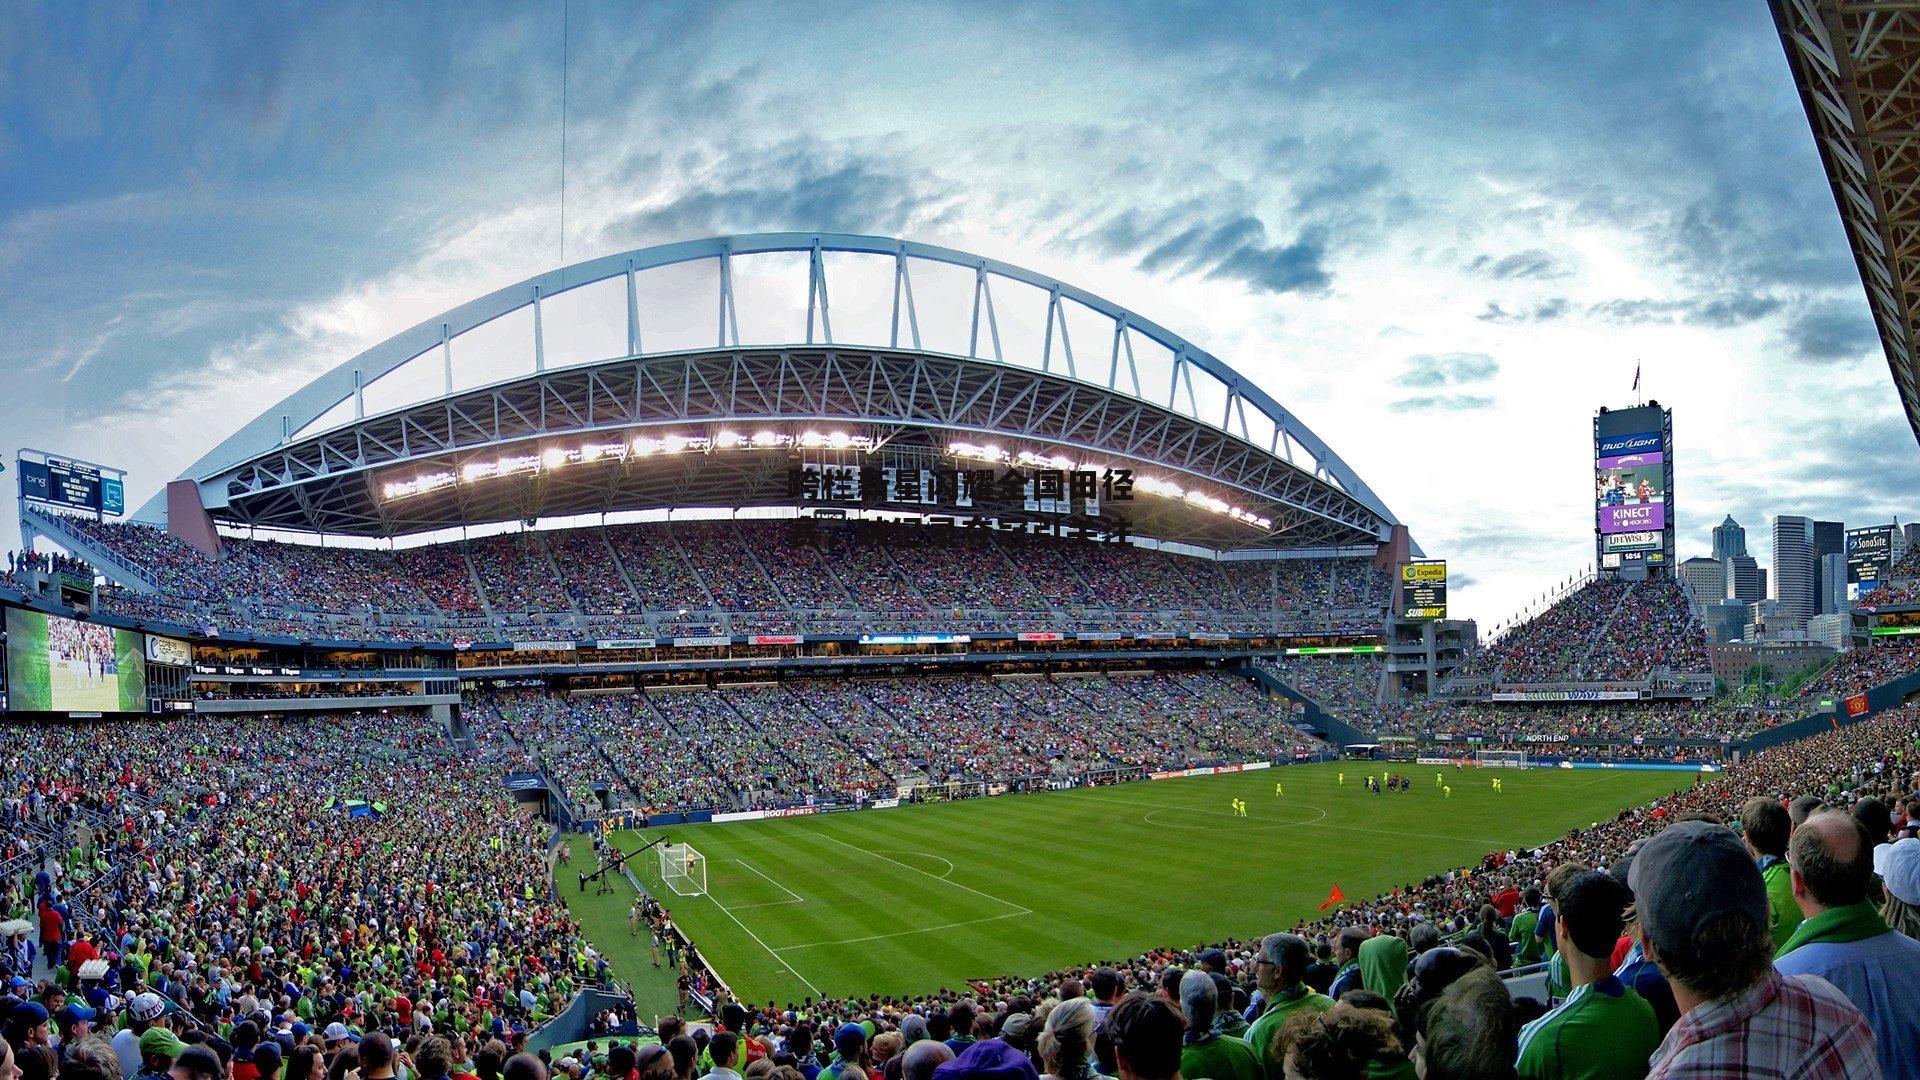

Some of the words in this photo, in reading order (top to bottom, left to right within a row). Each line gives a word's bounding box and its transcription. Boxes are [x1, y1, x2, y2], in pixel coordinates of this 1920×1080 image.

[1628, 439, 1658, 447] LIGHT
[26, 474, 46, 487] bing
[1613, 507, 1652, 519] KINECT
[1858, 535, 1886, 549] SonoSite
[1405, 607, 1445, 618] SUBWAY
[686, 638, 710, 646] Qwest
[1526, 734, 1553, 743] NORTH
[1554, 734, 1570, 742] END
[764, 808, 786, 818] ROOT
